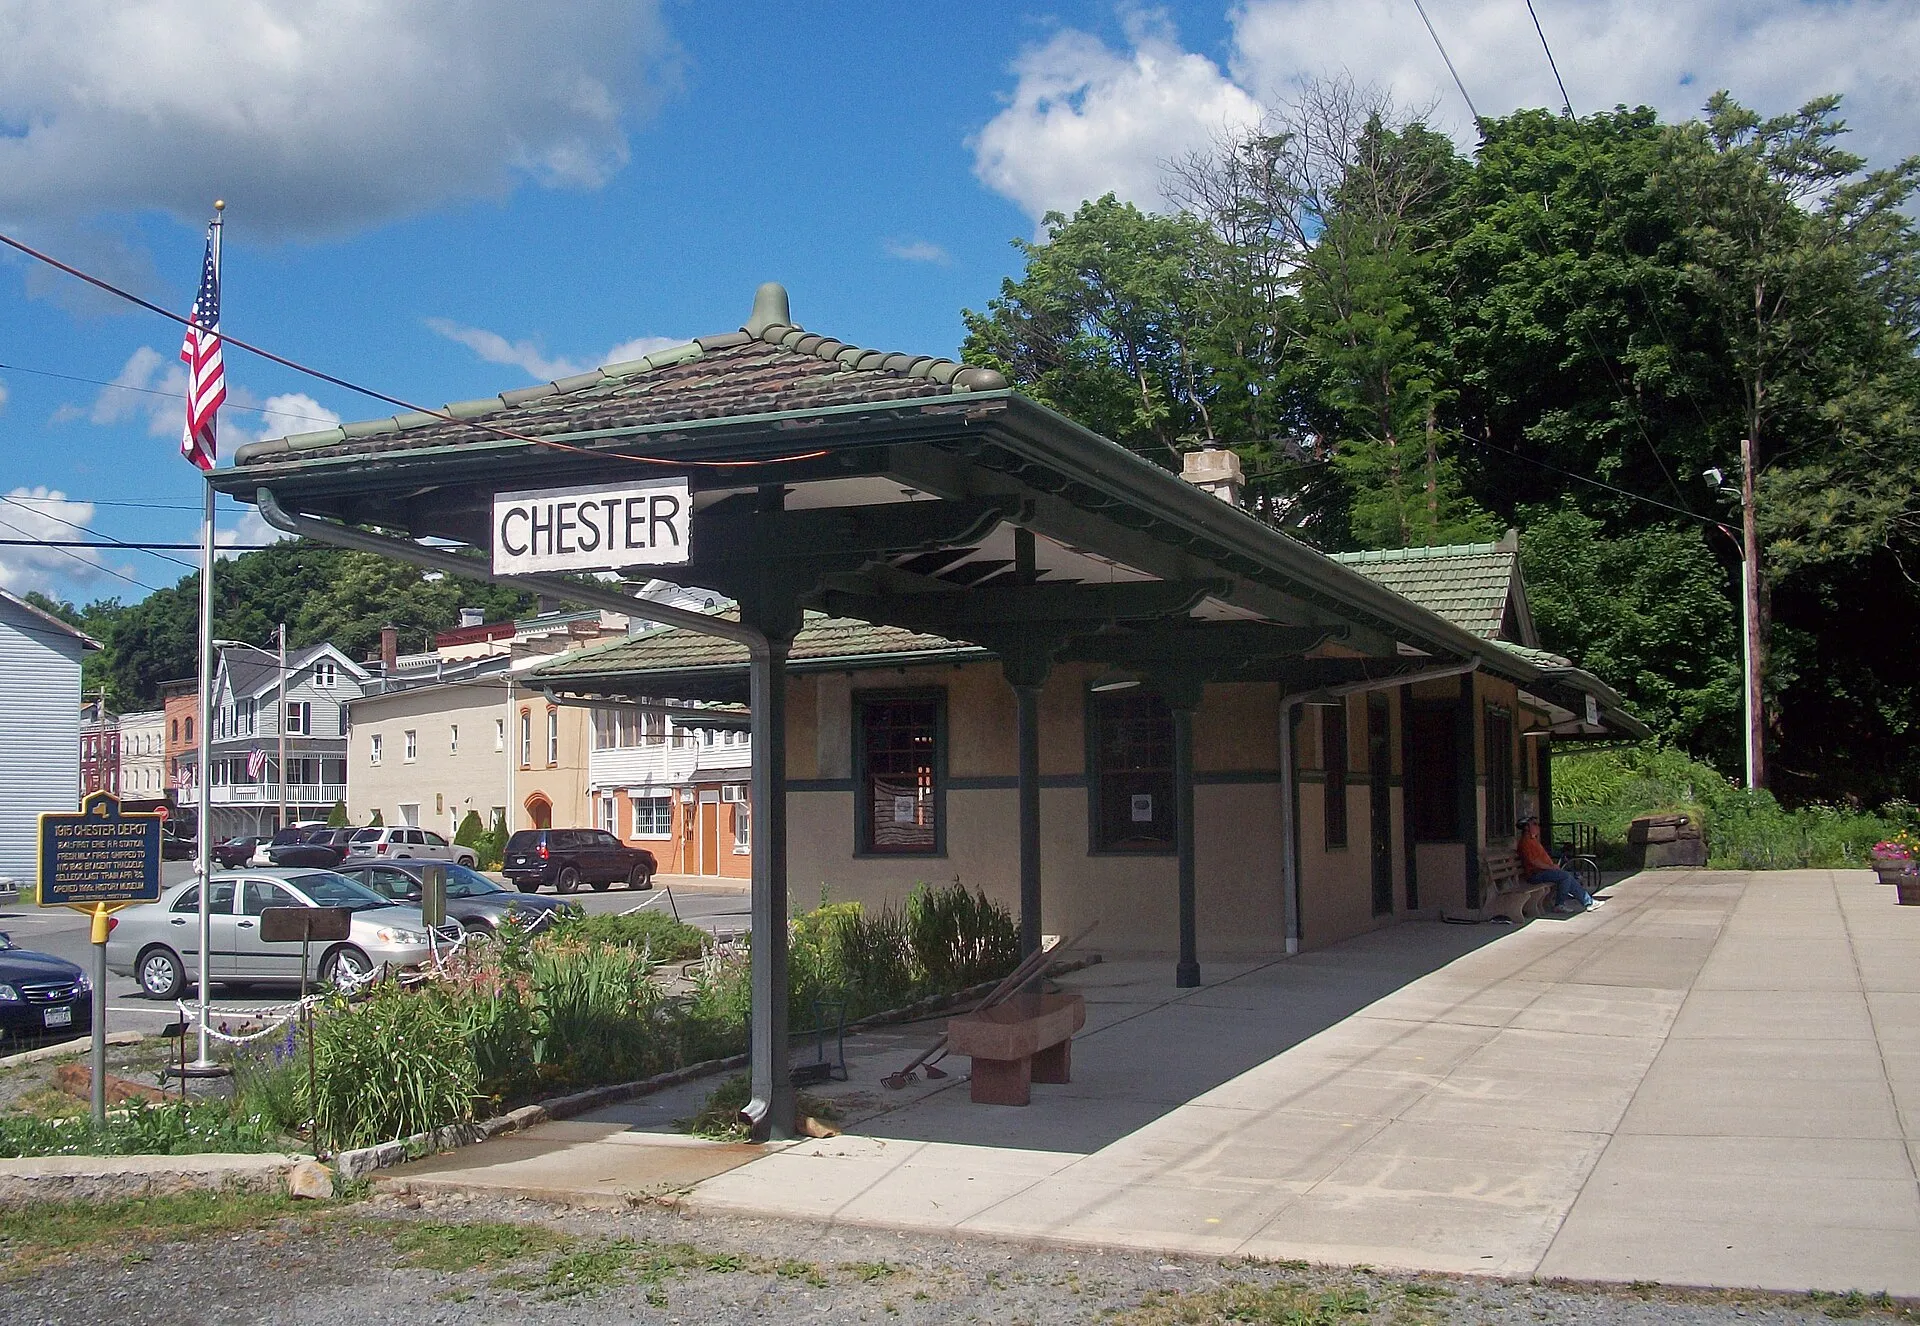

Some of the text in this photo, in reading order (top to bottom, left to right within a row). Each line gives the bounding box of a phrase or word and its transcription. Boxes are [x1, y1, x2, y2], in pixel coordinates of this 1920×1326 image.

[501, 495, 679, 557] CHESTER
[55, 823, 148, 836] 1915 CHESTER DEPOT
[137, 850, 146, 858] TO
